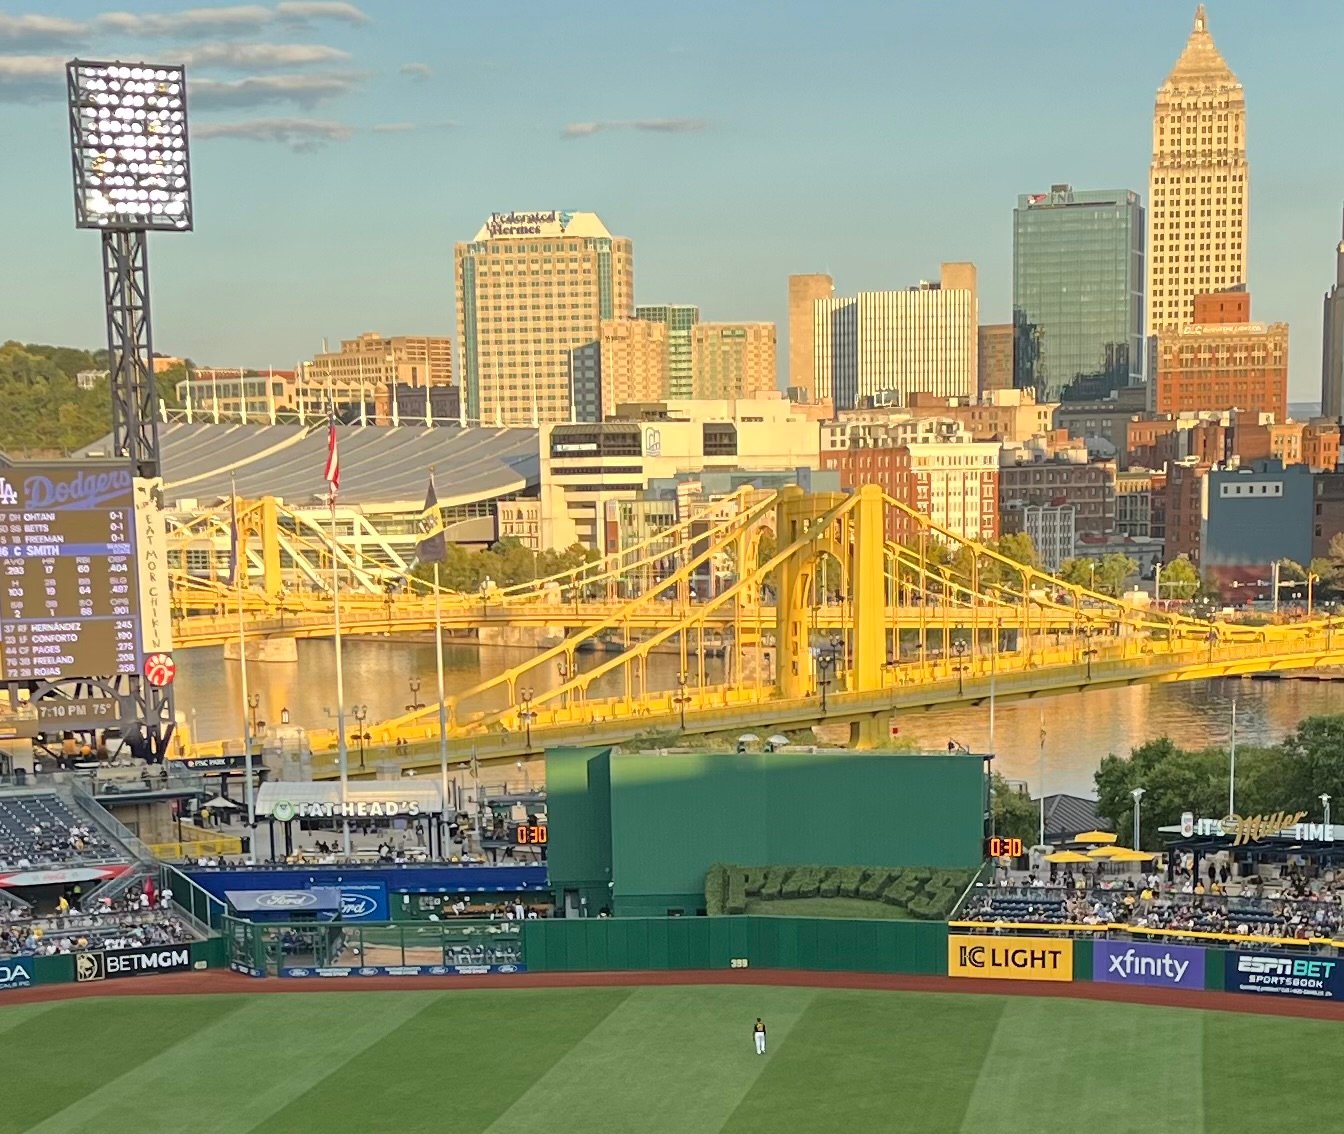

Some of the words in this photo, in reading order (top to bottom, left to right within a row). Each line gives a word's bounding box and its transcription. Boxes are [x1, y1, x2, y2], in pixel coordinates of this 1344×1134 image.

[492, 210, 556, 224] Federated
[487, 221, 541, 238] Hermes
[24, 470, 131, 509] Dodgers
[23, 513, 55, 521] OHTANI
[24, 523, 49, 532] BETTS
[146, 514, 155, 545] EAT
[24, 535, 64, 543] FREEMAN
[26, 545, 60, 556] SMITH
[146, 550, 157, 583] MOR
[31, 634, 78, 643] CONFORTO
[32, 645, 60, 654] PAGES
[33, 656, 74, 665] FREELAND
[34, 667, 61, 676] ROJAS
[40, 706, 65, 717] 7:10
[68, 705, 86, 716] PM
[93, 703, 111, 715] 75°
[300, 802, 333, 817] FAT
[342, 800, 419, 817] HEAD'S
[1228, 811, 1307, 846] Miller
[1295, 823, 1335, 841] TIME
[725, 867, 965, 918] PIRATES
[264, 893, 306, 907] Ford
[107, 950, 188, 973] BETMGM
[959, 945, 985, 968] IC
[991, 948, 1062, 969] LIGHT
[1109, 949, 1189, 982] xfinity
[1292, 960, 1336, 979] BET
[1248, 975, 1324, 989] SPORTSBOOK
